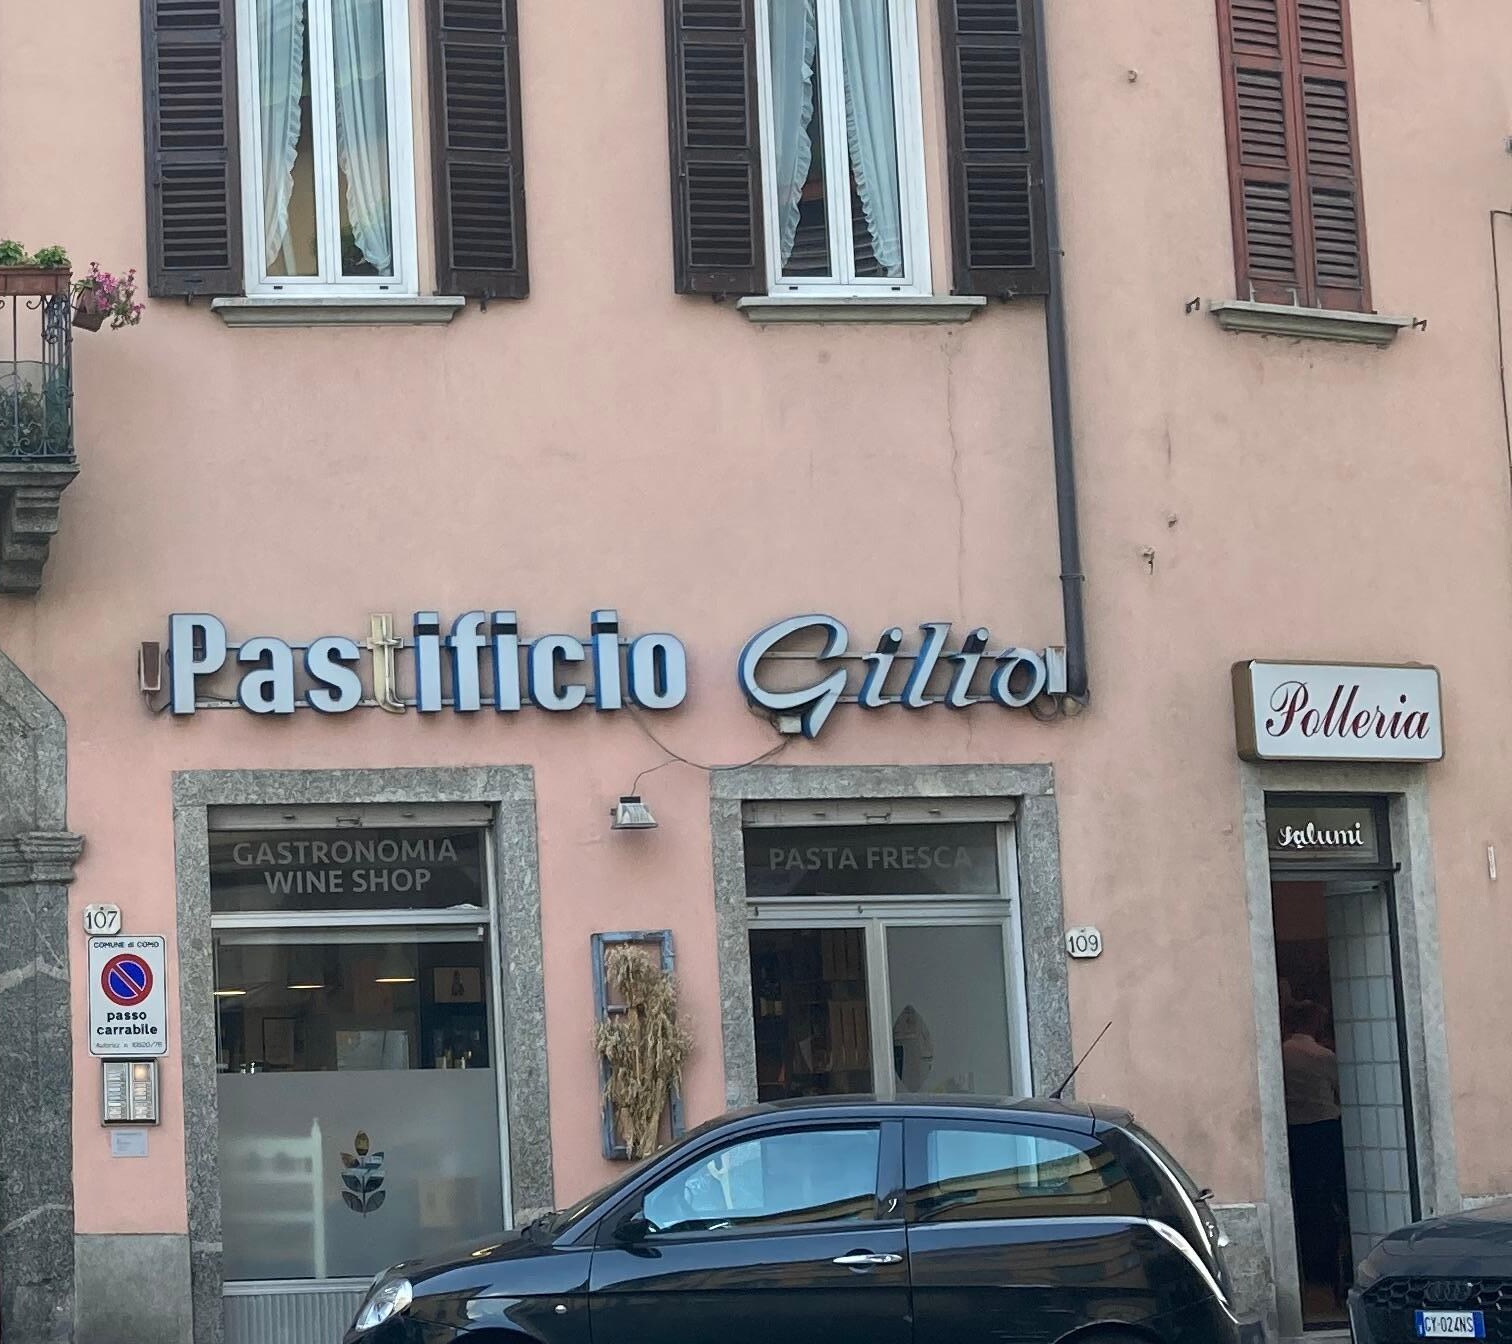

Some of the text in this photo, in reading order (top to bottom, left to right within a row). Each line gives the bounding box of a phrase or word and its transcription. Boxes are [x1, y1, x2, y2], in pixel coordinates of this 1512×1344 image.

[168, 609, 1047, 739] Pastificio Gilio
[1265, 680, 1431, 740] Polleria
[1278, 822, 1364, 849] salumi
[232, 838, 459, 865] GASTRONOMIA
[768, 845, 974, 871] PASTA FRESCA
[264, 868, 432, 895] WINE SHOP
[86, 910, 118, 930] 107
[1068, 934, 1099, 953] 109
[96, 1023, 158, 1035] carrabile
[106, 1011, 148, 1023] passo
